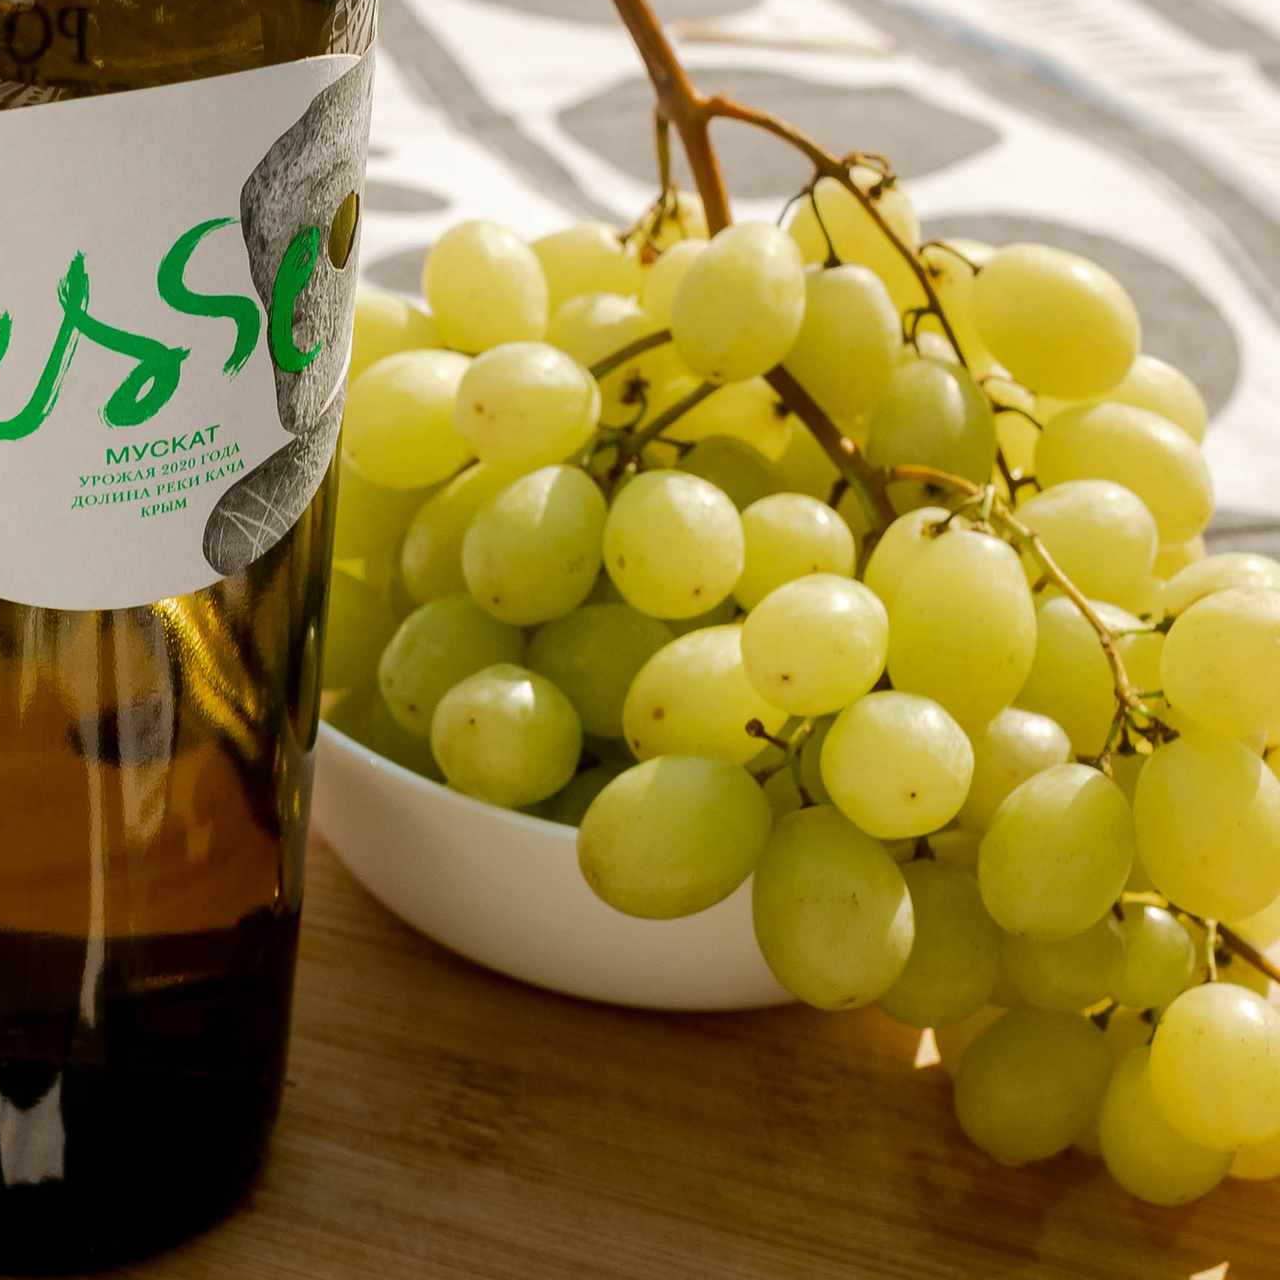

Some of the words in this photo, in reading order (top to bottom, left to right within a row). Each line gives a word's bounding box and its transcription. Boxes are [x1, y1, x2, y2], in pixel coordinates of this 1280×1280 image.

[78, 467, 156, 488] УРОЖАЯ
[161, 457, 196, 476] 2020
[200, 443, 242, 466] ГОДА
[106, 424, 220, 466] МУСКАТ
[71, 487, 151, 510] ДОЛИНА
[157, 475, 200, 496] РЕКИ
[205, 458, 245, 483] КАЧА
[140, 496, 188, 518] КРЫМ
